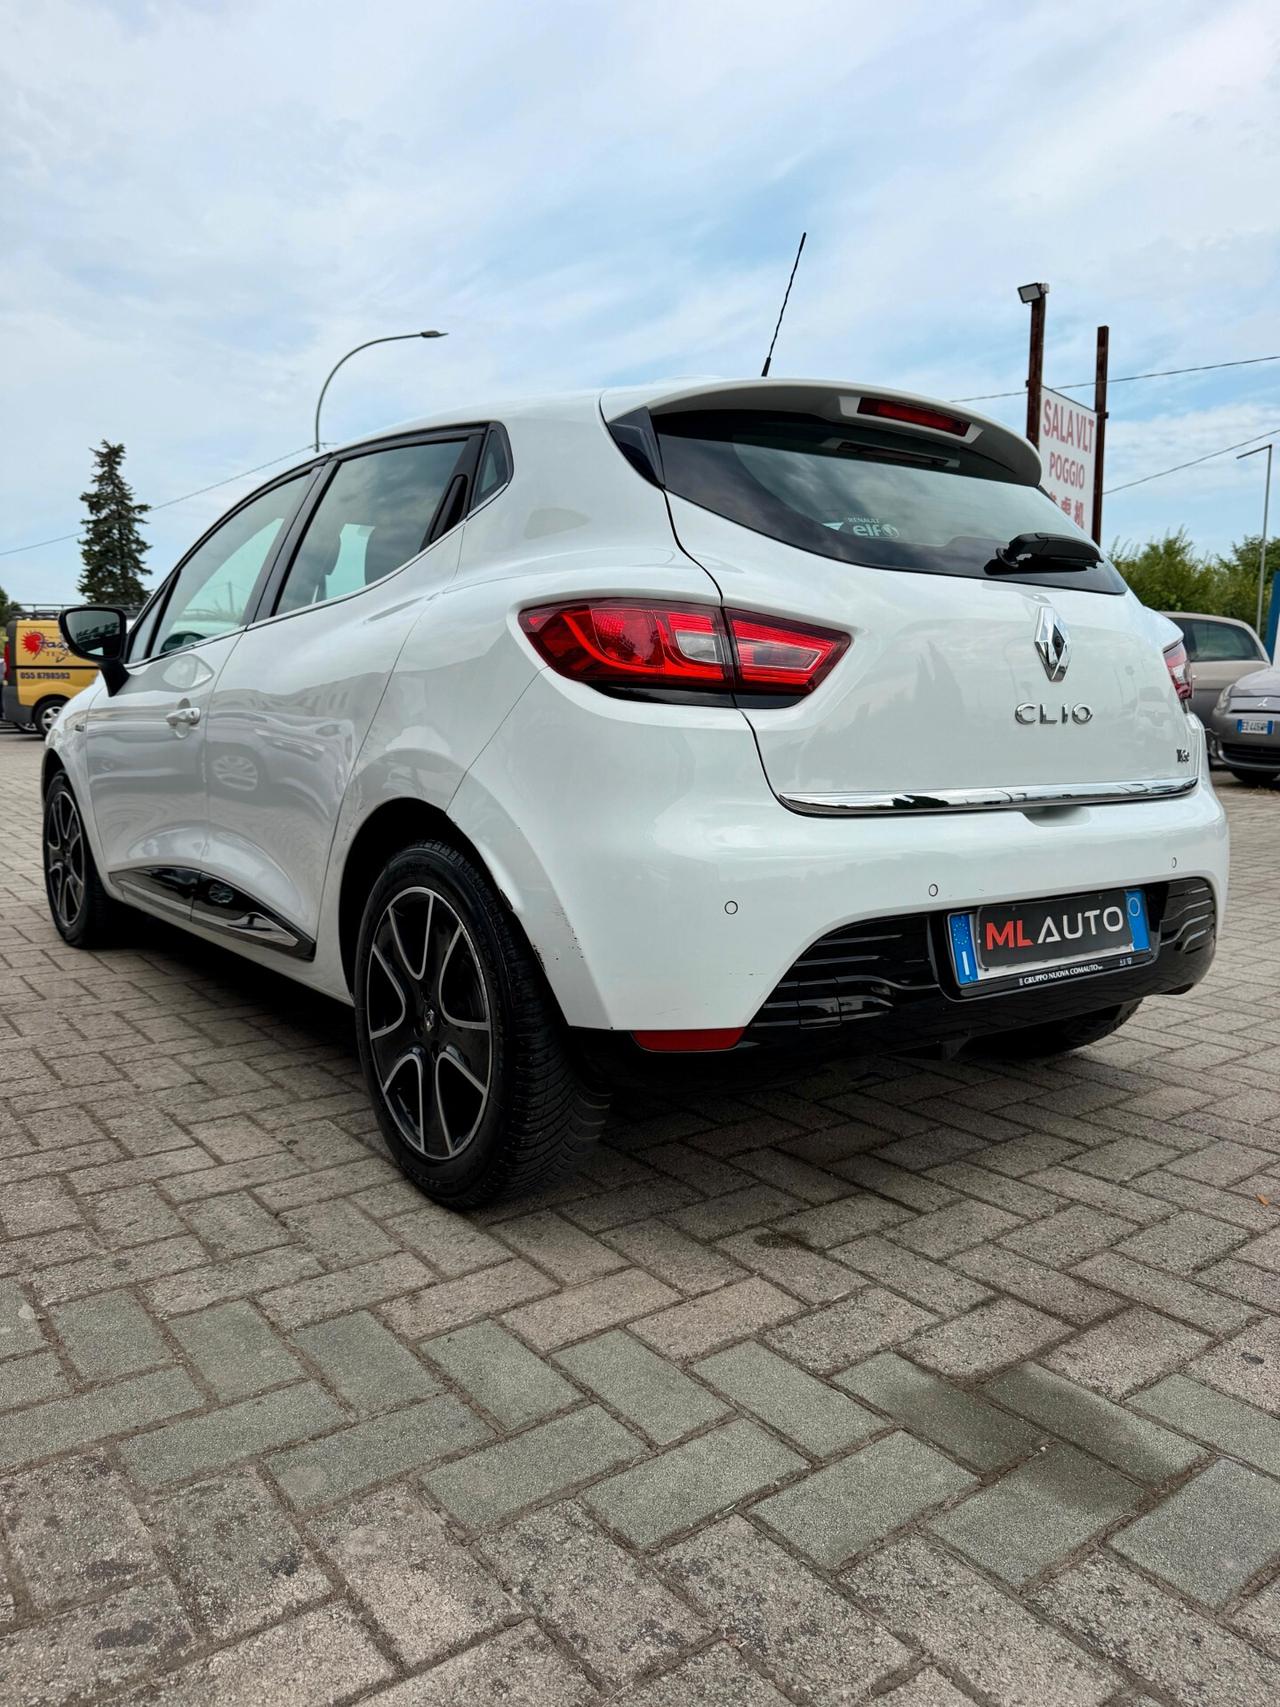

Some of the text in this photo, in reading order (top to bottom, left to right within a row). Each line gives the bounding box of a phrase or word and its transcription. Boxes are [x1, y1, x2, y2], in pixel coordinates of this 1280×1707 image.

[1043, 399, 1094, 453] SALA VLT
[1049, 451, 1085, 489] POGGIO
[853, 523, 881, 537] elf
[1015, 703, 1093, 725] CLIO
[986, 906, 1124, 950] ML AUTO
[1024, 973, 1048, 985] GRUPPO
[1049, 968, 1070, 980] NUOVA
